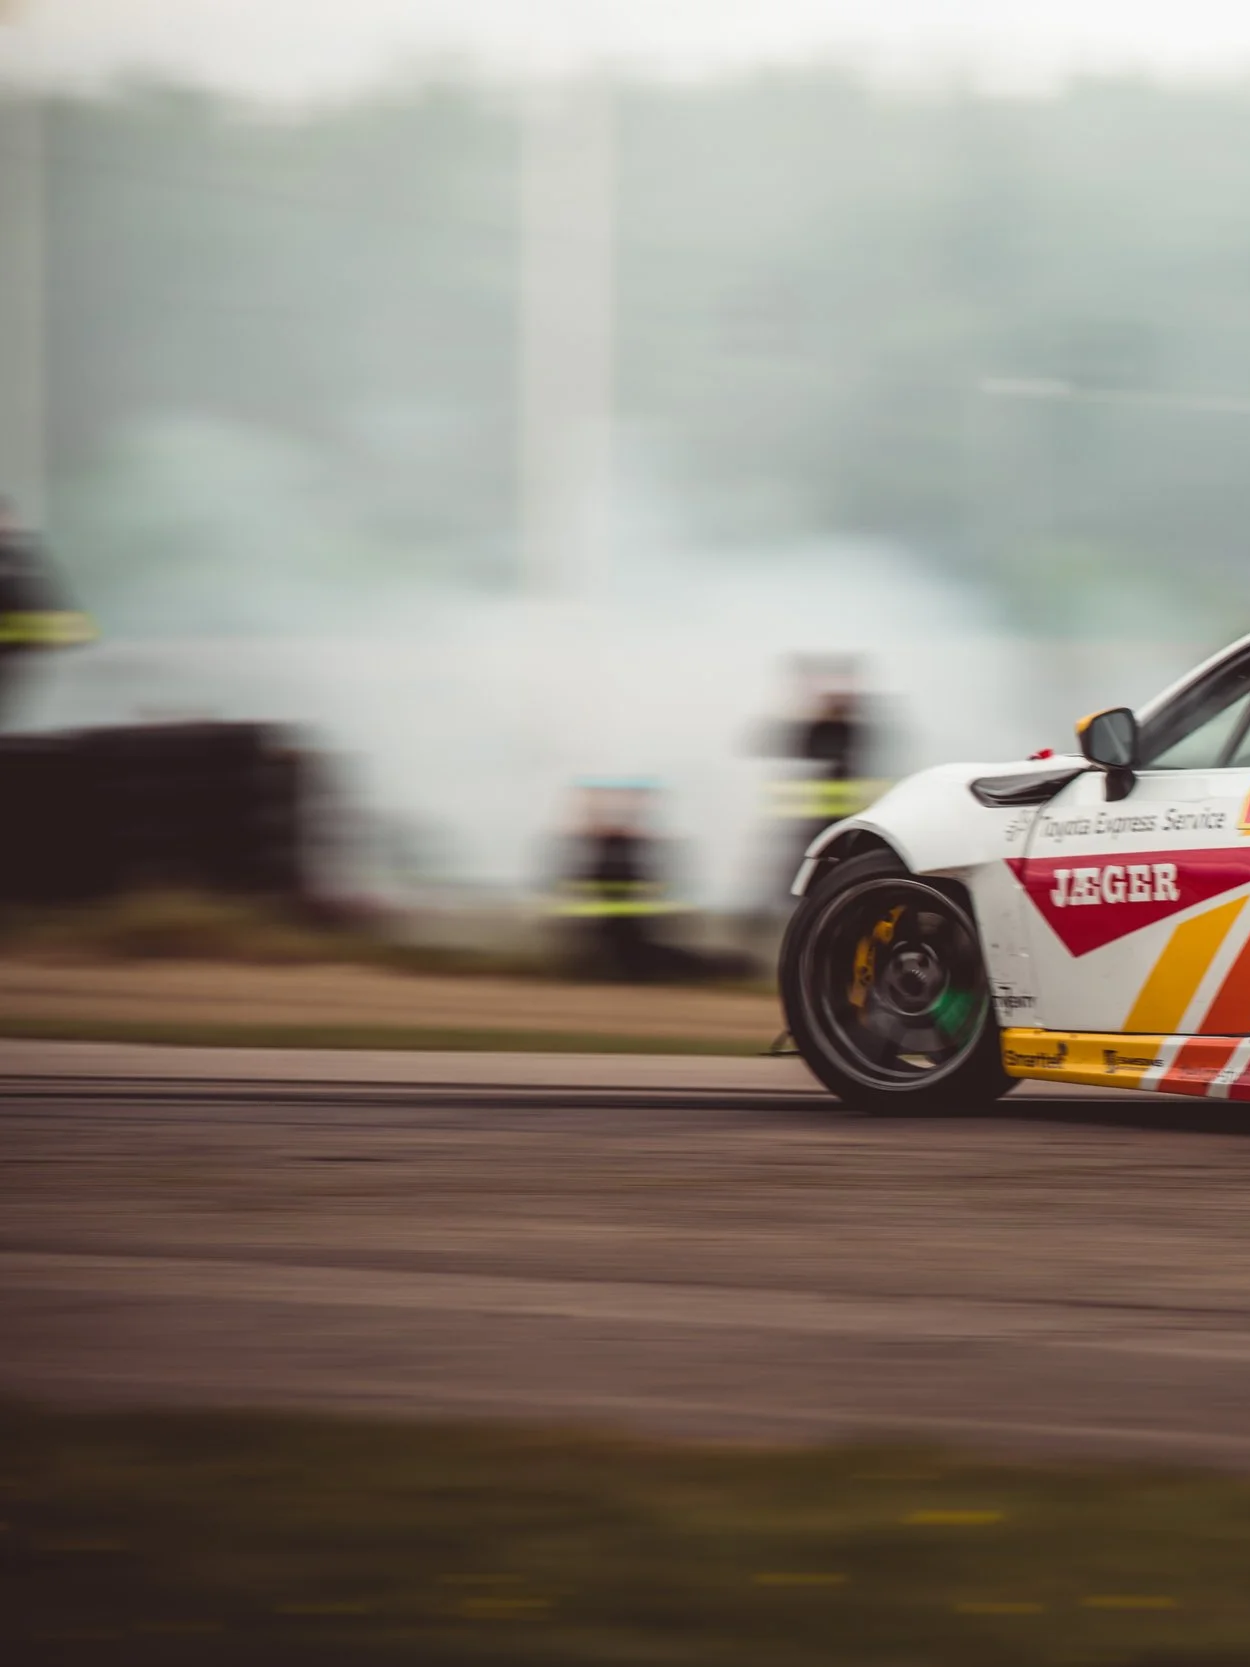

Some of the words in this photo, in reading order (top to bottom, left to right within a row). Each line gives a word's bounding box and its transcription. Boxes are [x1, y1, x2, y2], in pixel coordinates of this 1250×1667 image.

[1039, 815, 1091, 843] Toyota
[1095, 812, 1158, 840] Express
[1161, 807, 1227, 832] Service
